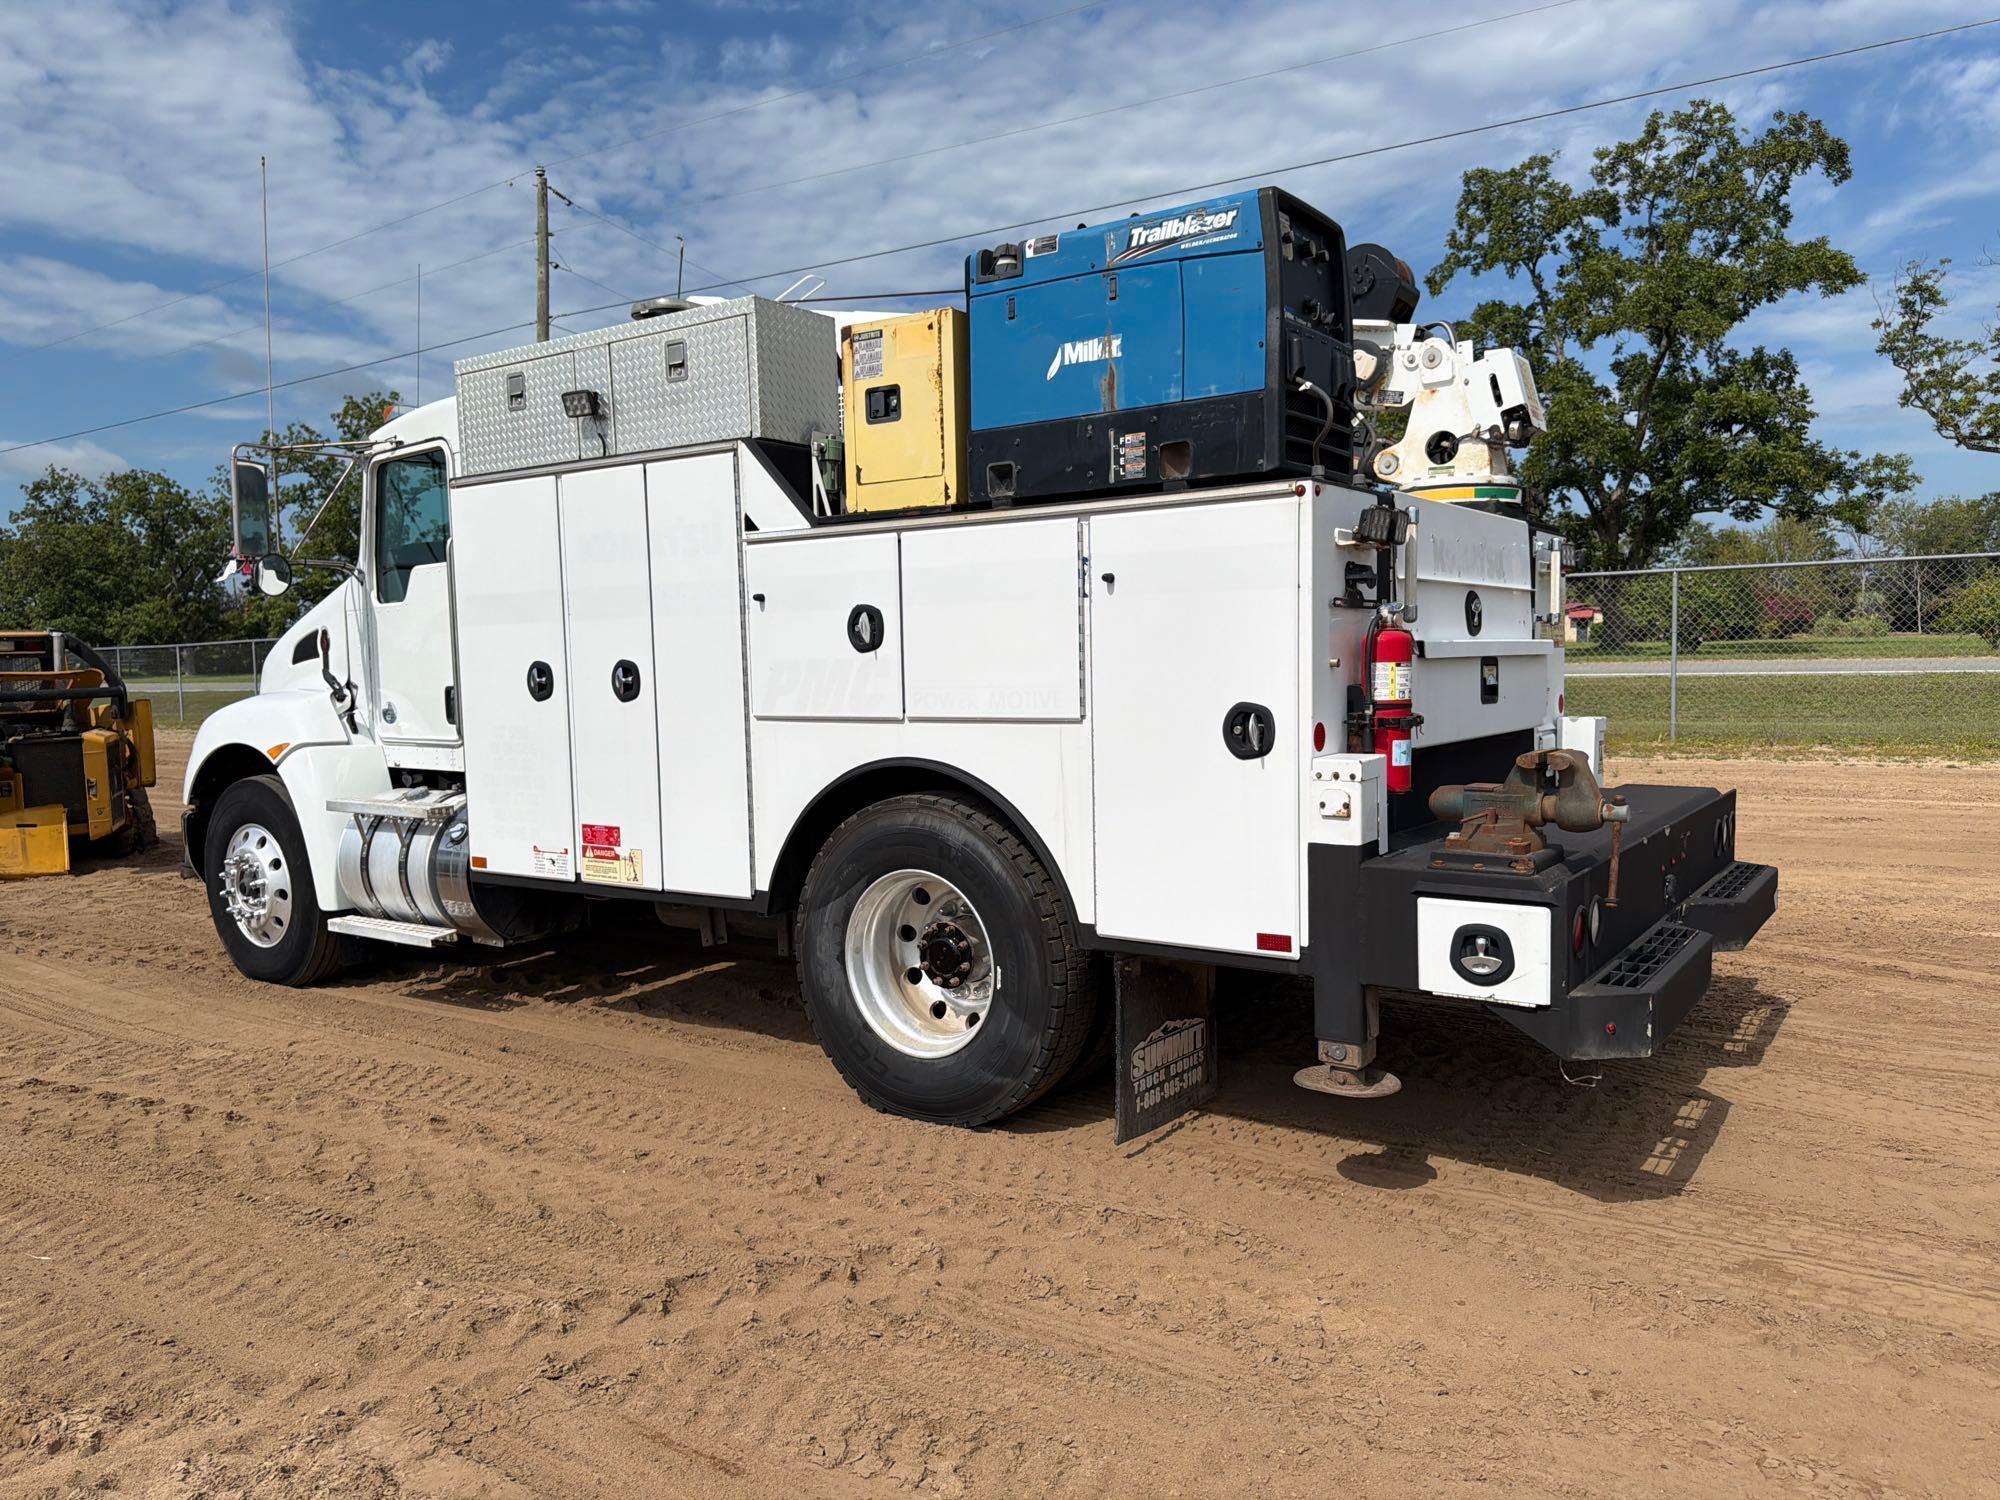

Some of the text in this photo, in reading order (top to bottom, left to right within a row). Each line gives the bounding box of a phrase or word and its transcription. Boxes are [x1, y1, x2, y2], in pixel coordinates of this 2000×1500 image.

[1130, 208, 1238, 248] Trailblazer
[987, 688, 1065, 711] MOTIVE
[593, 849, 615, 857] DANGER
[1132, 1023, 1204, 1078] SUMMIT
[1133, 1051, 1205, 1095] TRUCK BODIES
